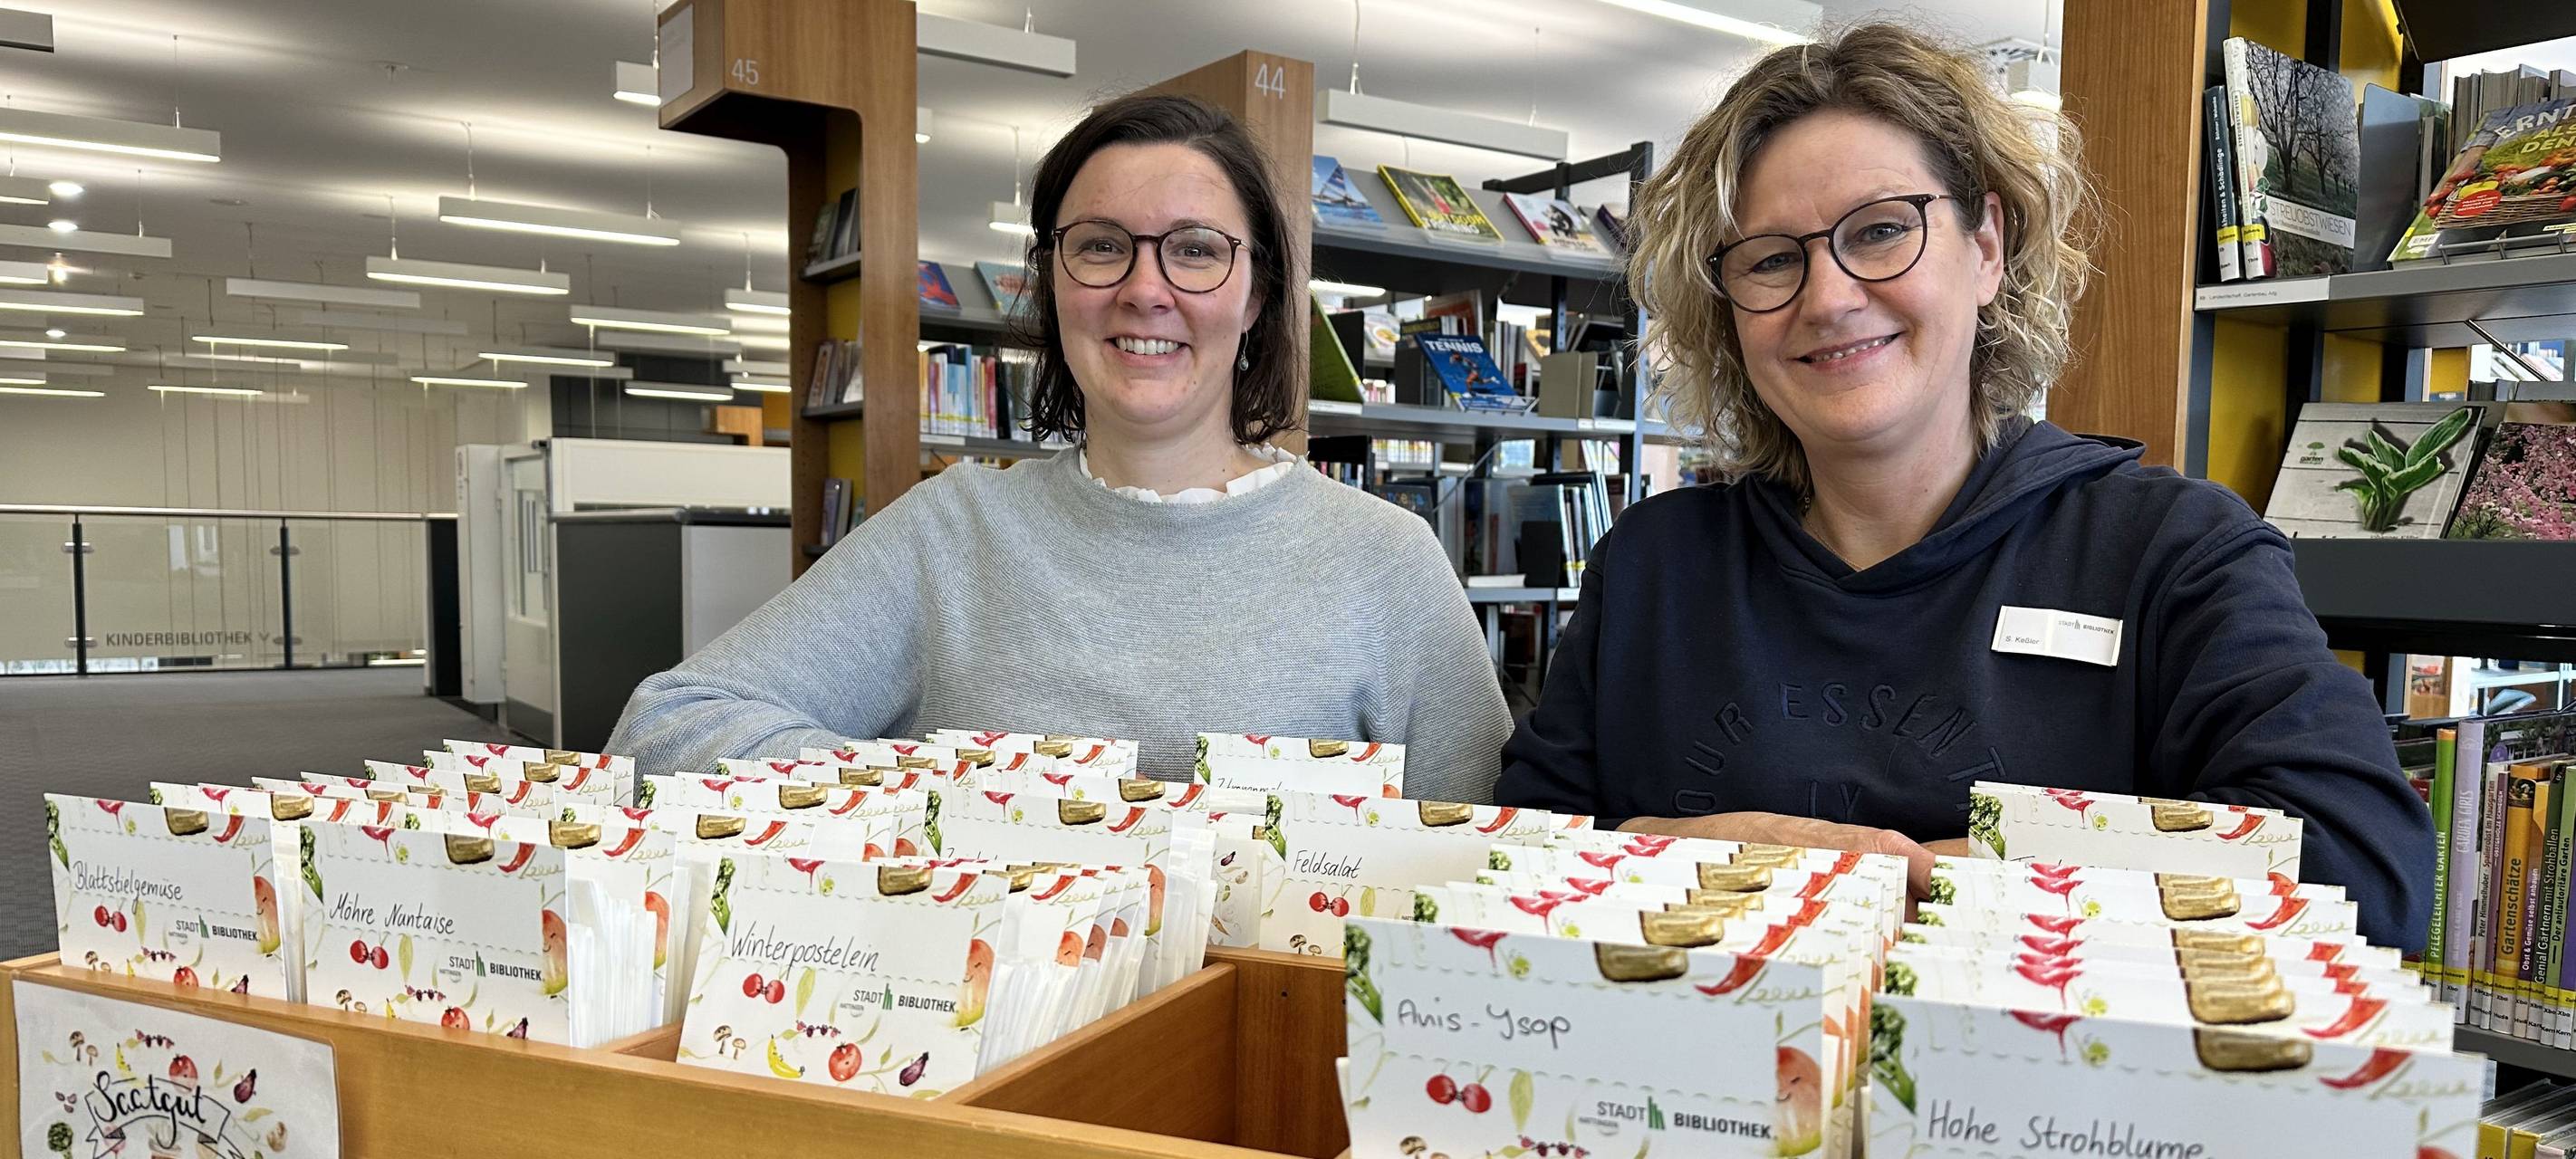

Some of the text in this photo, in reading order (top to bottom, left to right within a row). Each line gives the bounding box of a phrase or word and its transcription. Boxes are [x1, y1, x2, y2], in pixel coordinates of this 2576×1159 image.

[731, 58, 759, 86] 45
[1254, 62, 1286, 100] 44
[2521, 136, 2576, 154] DEN
[2216, 148, 2226, 190] Schädlinge
[2269, 200, 2352, 236] STREUOBSTWIESEN
[1425, 340, 1484, 354] TENNIS
[106, 631, 252, 647] KINDERBIBLIOTHEK
[2082, 624, 2115, 635] BIBLIOTHEK
[1778, 682, 2006, 783] ESSENT
[2486, 781, 2495, 819] Hausgarten
[2455, 790, 2474, 854] GARDEN GIRLS
[1293, 849, 1362, 879] Feldsalat
[2437, 831, 2446, 872] GARTEN
[2483, 830, 2493, 867] Spalierobst
[73, 860, 183, 915] Blattstielgemüse
[2528, 868, 2539, 896] anbauen
[2552, 838, 2571, 942] Der antiautoritäre Garten
[330, 892, 455, 934] Möhre Nantaise
[2429, 874, 2446, 958] PFLEGELEICHTER
[2477, 873, 2489, 937] Peter Himmelhuber
[2501, 857, 2522, 955] Gartenschätze
[2526, 898, 2536, 917] selbst
[2534, 829, 2559, 984] Genial Gärtnern mit Strohballen
[176, 920, 199, 934] STADT
[2524, 919, 2534, 946] Gemüse
[449, 956, 476, 971] STADT
[731, 920, 879, 981] Winterpostelein
[2522, 954, 2531, 971] Obst
[852, 990, 884, 1004] STADT
[91, 1070, 207, 1150] Saatgut
[1597, 1101, 1646, 1121] STADT
[1928, 1098, 2000, 1144] Hohe
